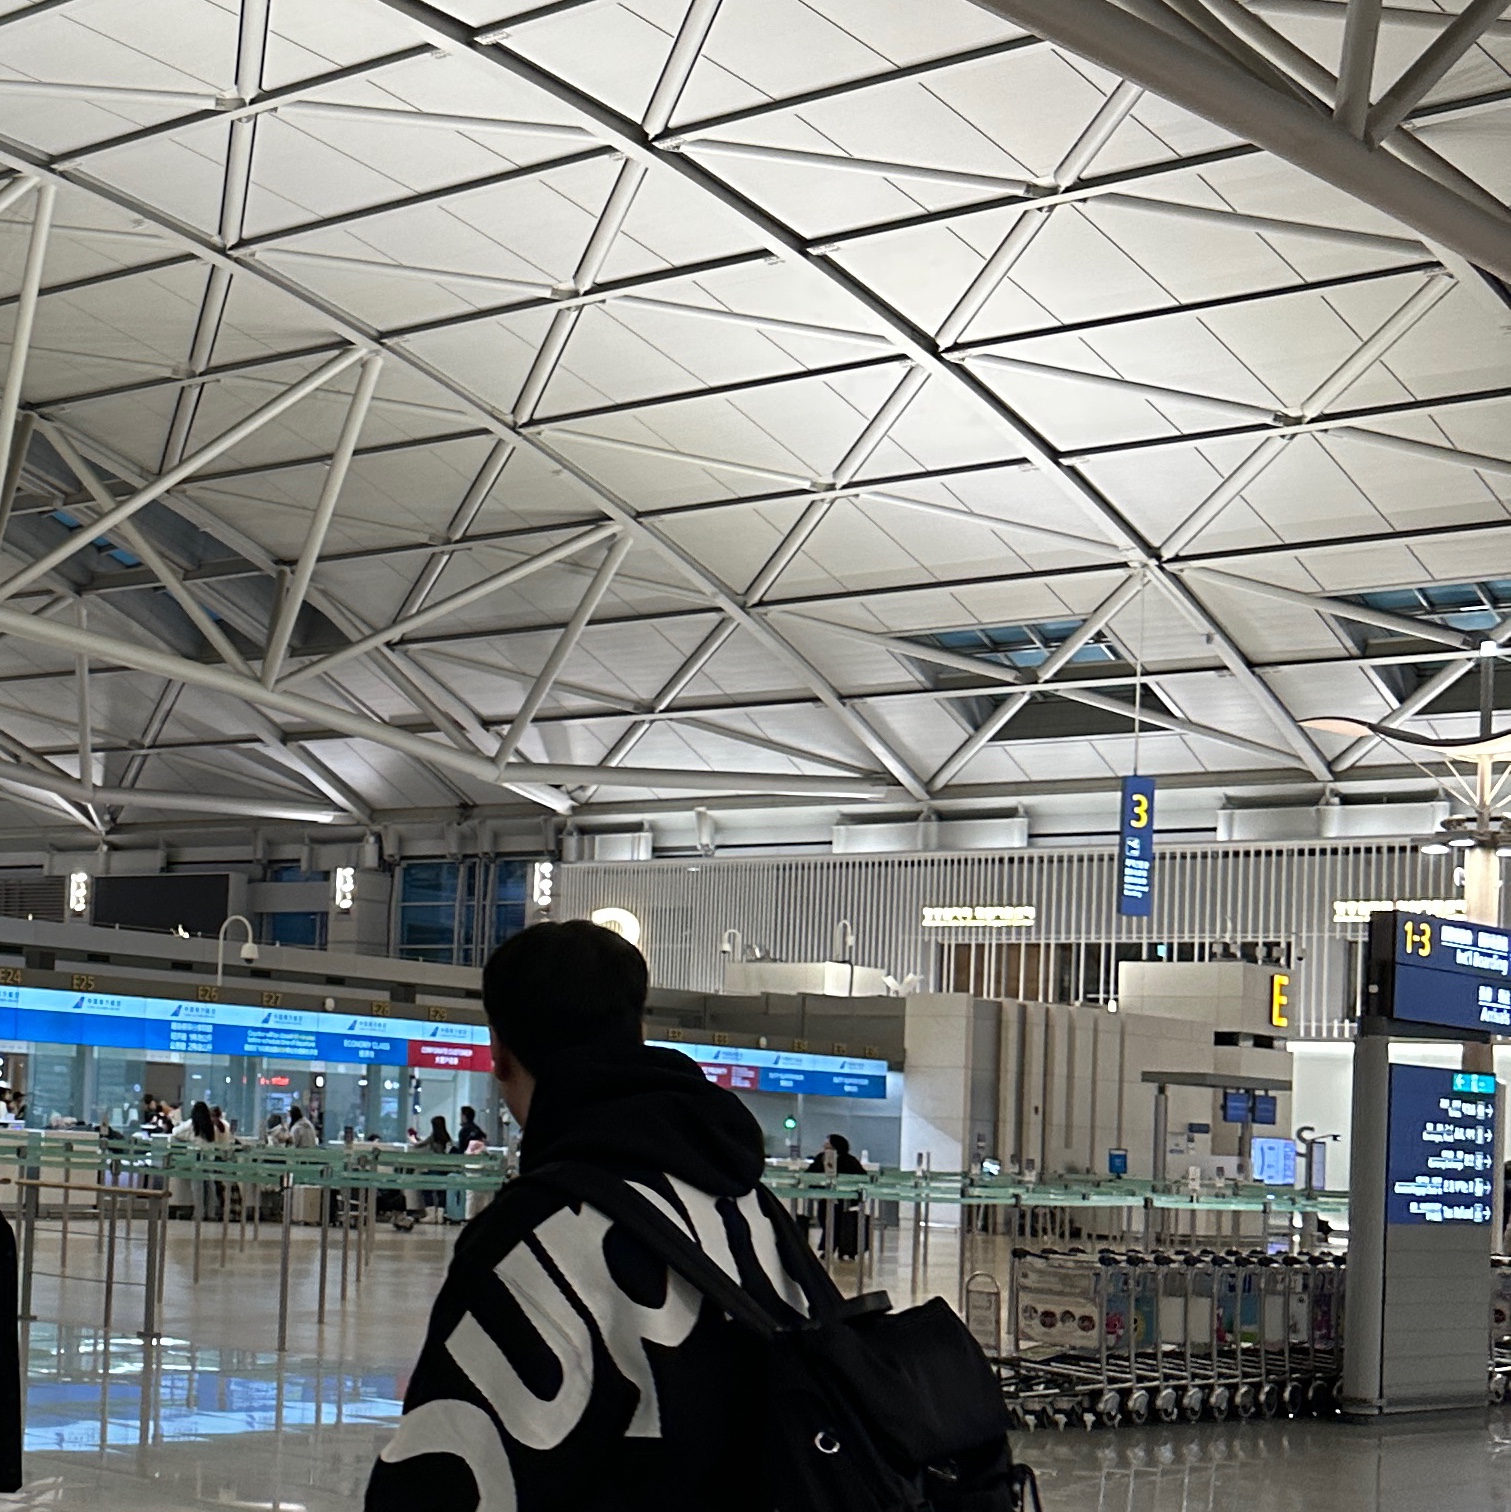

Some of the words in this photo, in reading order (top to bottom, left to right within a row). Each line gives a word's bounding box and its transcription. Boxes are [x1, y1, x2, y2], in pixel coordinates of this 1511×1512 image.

[1129, 793, 1149, 829] 3
[1404, 921, 1432, 957] 1-3
[72, 974, 96, 991] E25
[197, 986, 219, 1001] E26
[261, 992, 283, 1007] E27
[1271, 973, 1289, 1028] E
